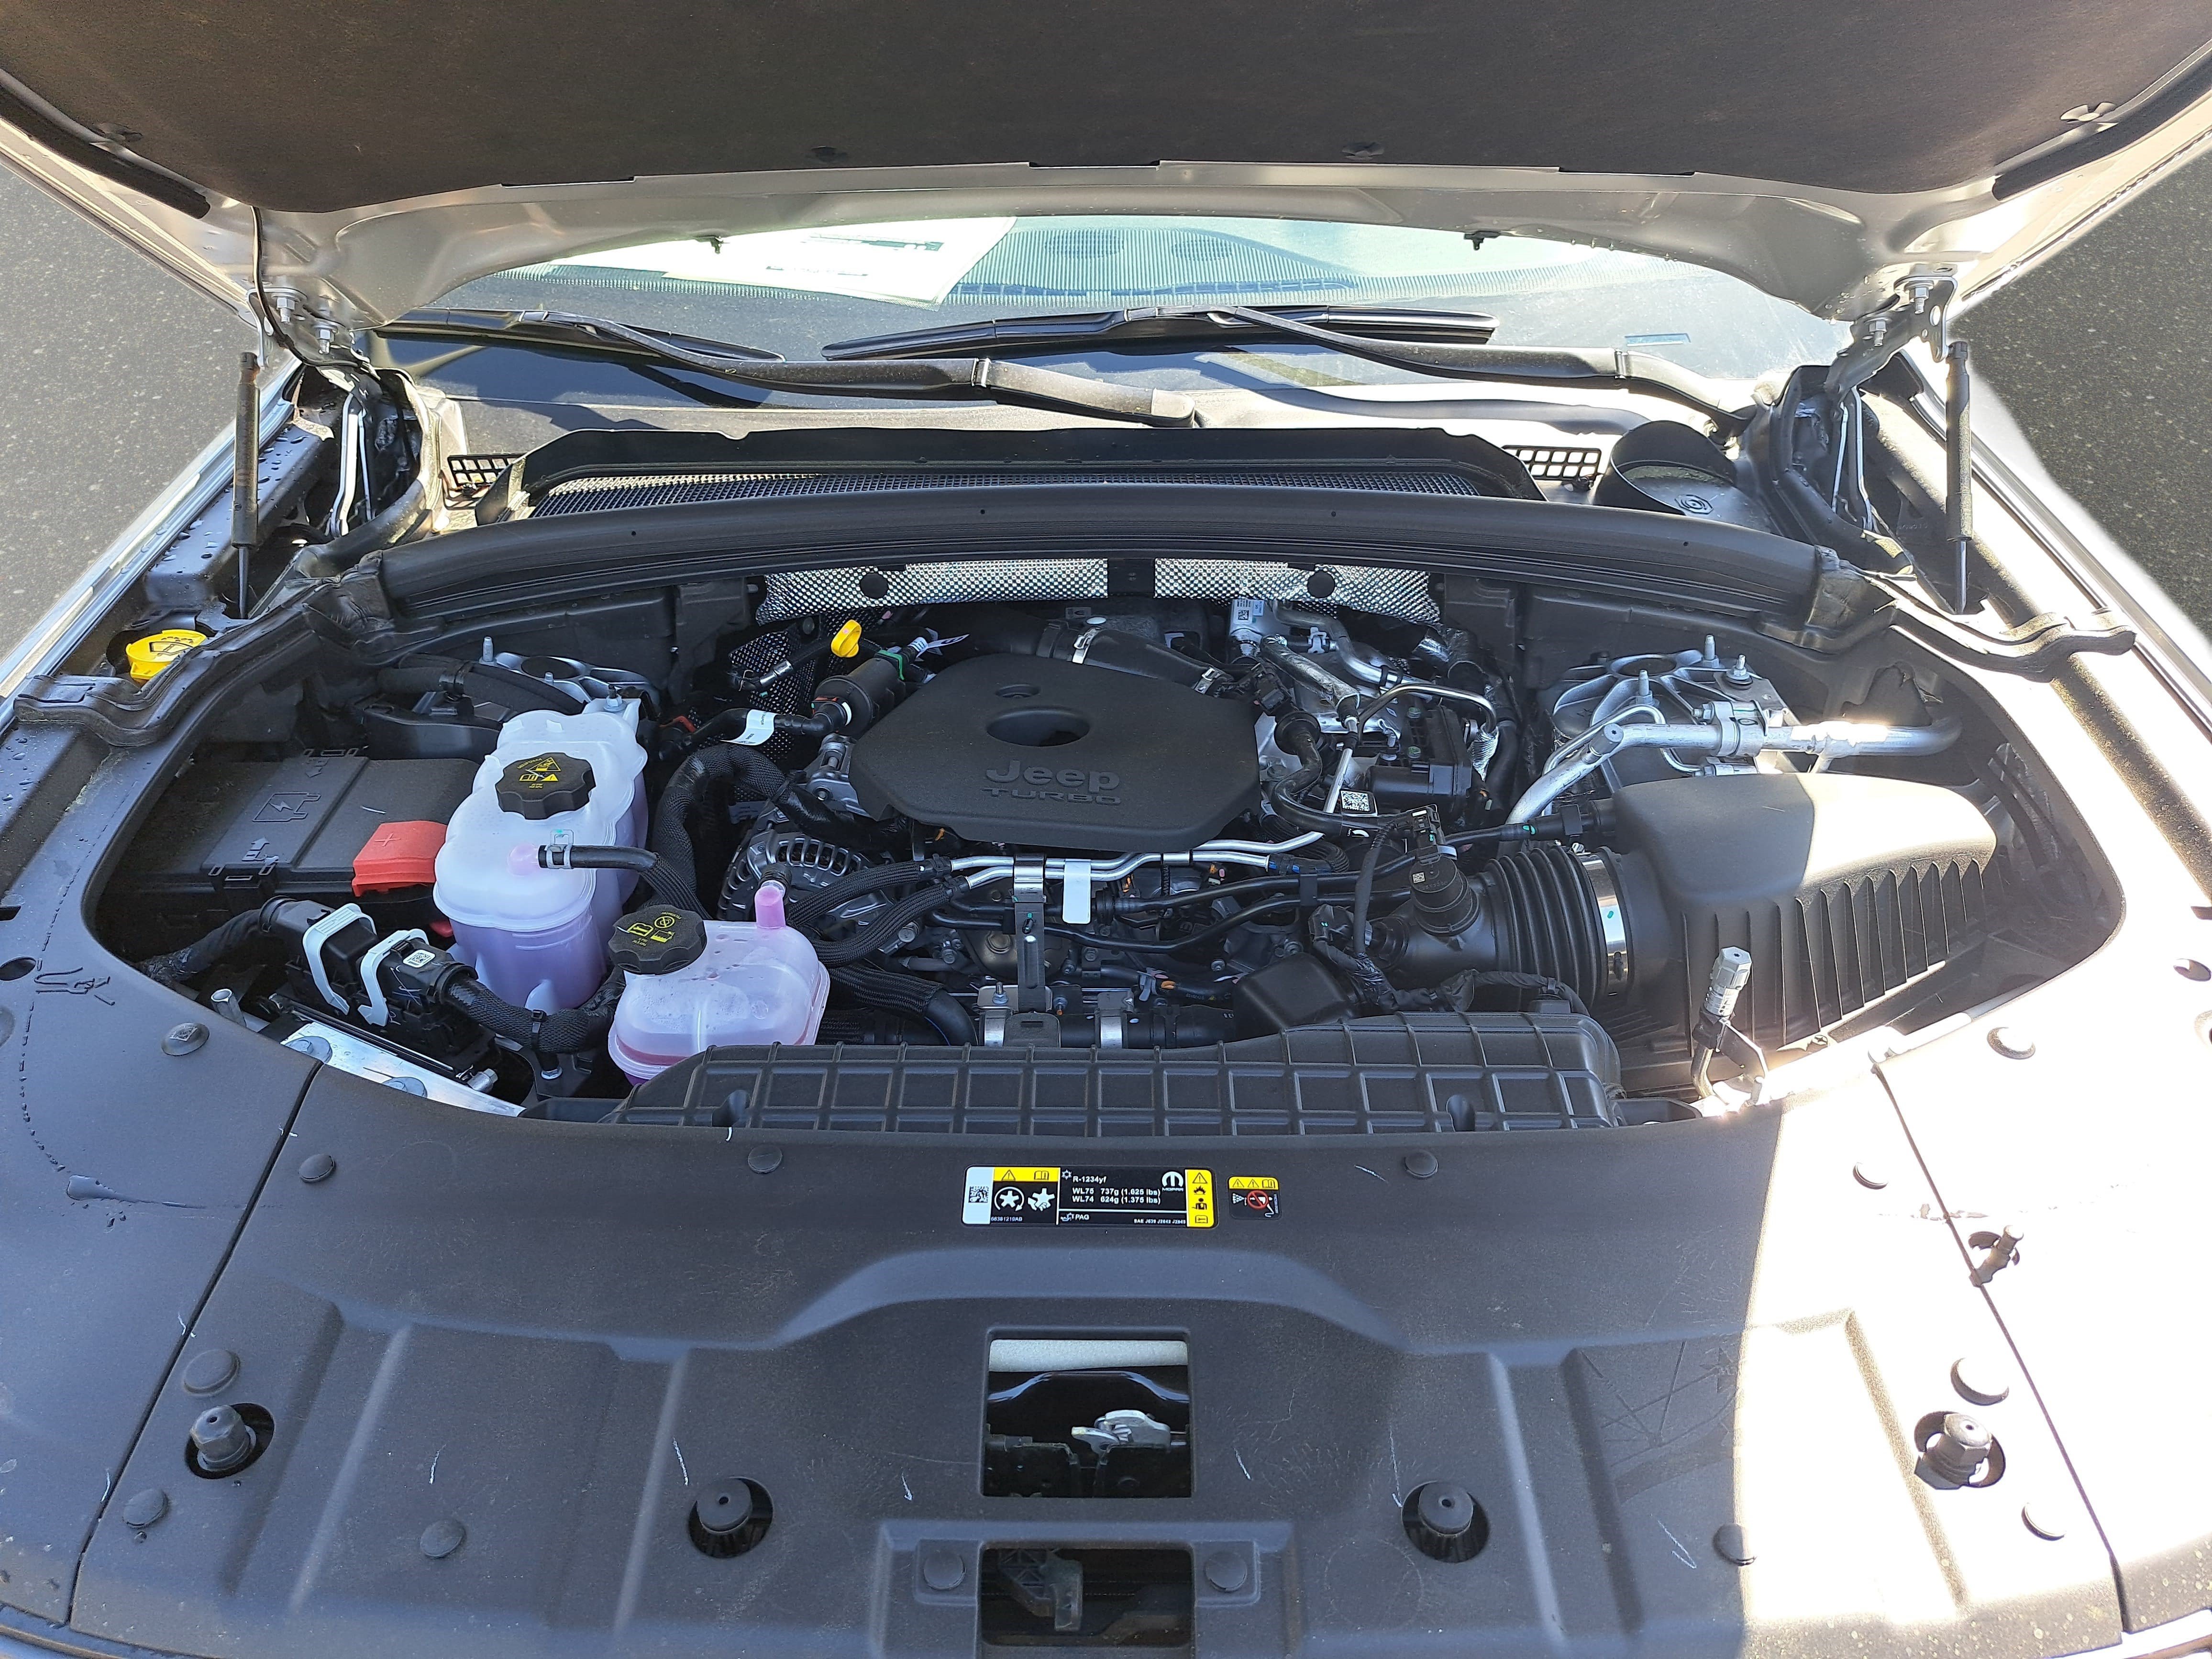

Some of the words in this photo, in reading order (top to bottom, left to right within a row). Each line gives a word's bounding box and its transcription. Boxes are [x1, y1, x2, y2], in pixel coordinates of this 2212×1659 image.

[985, 759, 1120, 794] Jeep
[981, 787, 1122, 805] TURBO
[1073, 1175, 1107, 1184] R-1234yf
[1100, 1188, 1119, 1196] 737g
[1146, 1188, 1161, 1197] lbs)
[1100, 1196, 1119, 1205] 624g
[1146, 1196, 1161, 1205] lbs)
